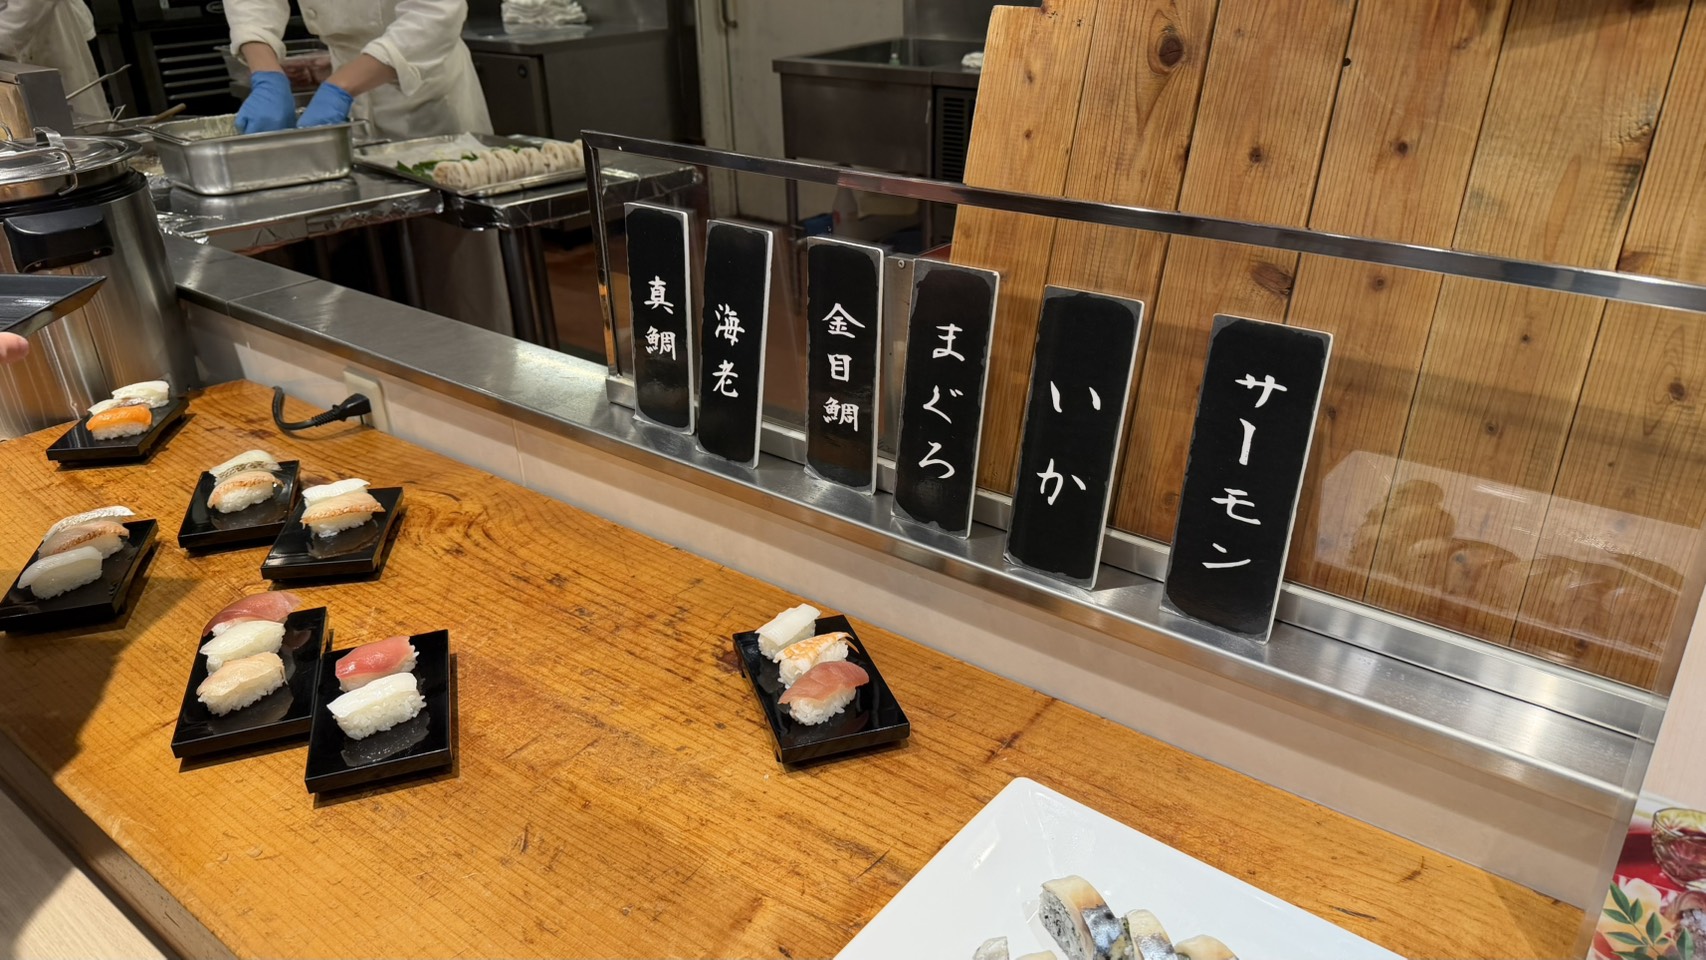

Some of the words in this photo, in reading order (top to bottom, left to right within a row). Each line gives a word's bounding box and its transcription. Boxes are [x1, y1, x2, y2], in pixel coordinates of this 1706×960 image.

[643, 275, 677, 361] 真鯛
[712, 303, 746, 398] 海老
[822, 302, 866, 432] 金目鯛
[918, 323, 966, 480] まぐろ
[1036, 380, 1102, 506] いか
[1202, 373, 1288, 569] サーモン
